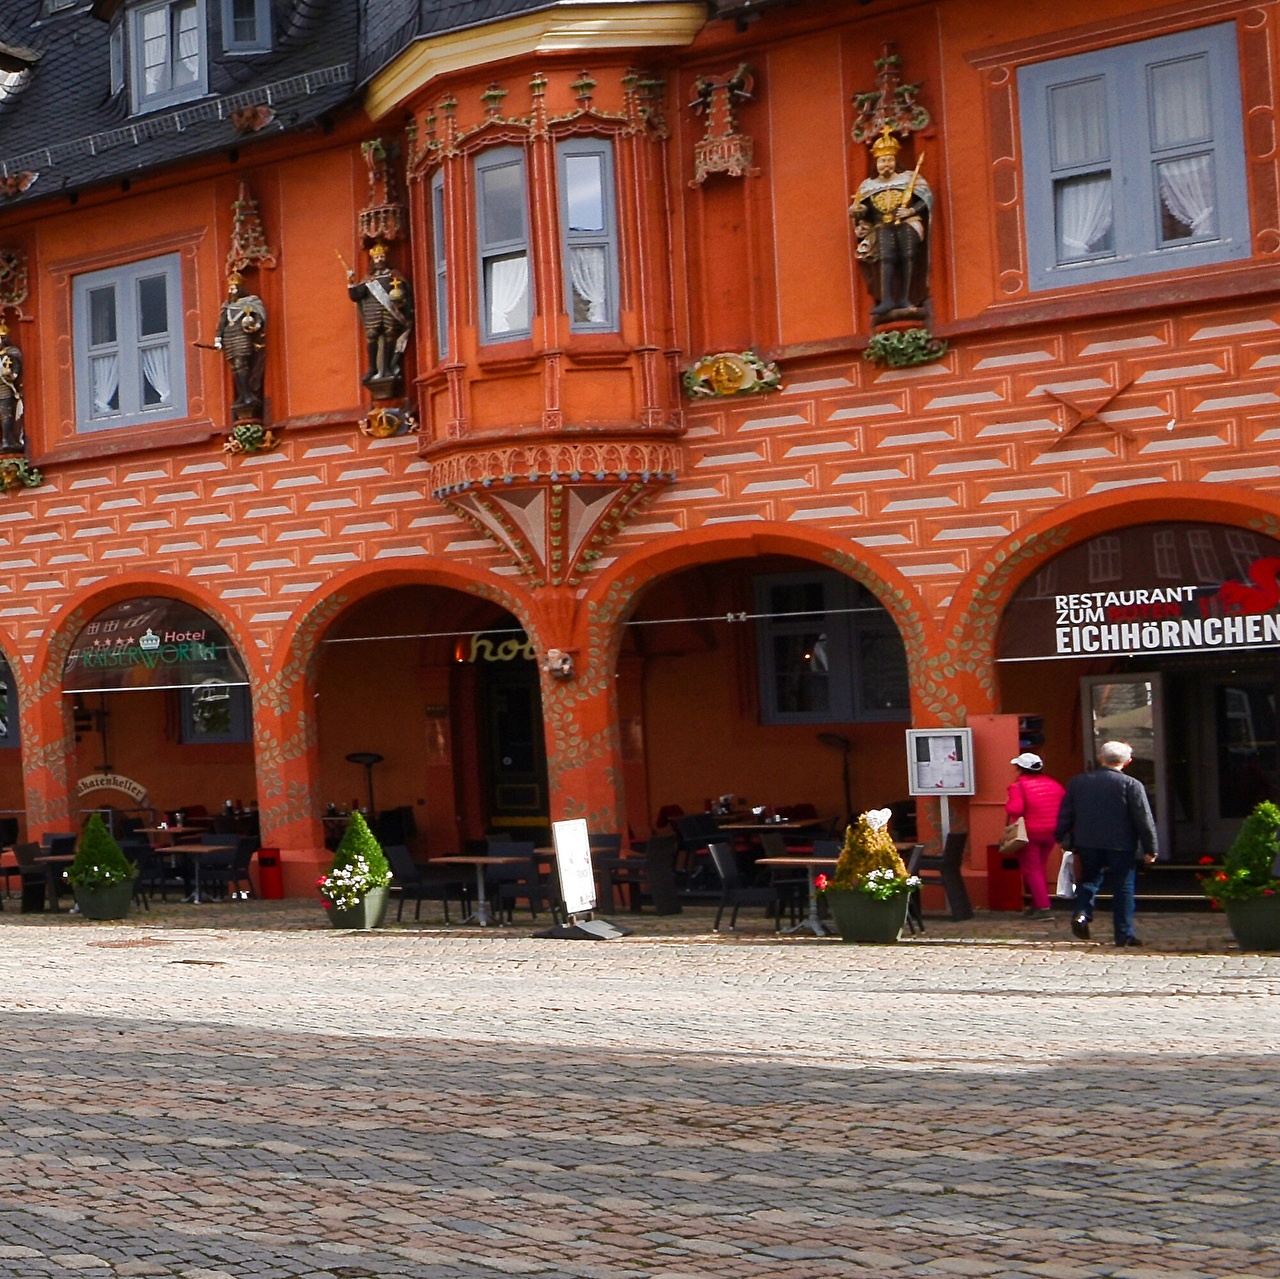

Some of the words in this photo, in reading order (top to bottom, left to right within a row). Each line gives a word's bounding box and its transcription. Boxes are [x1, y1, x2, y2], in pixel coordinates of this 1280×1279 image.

[1055, 586, 1197, 610] RESTAURANT
[1056, 607, 1105, 625] ZUM
[164, 629, 206, 643] Hotel
